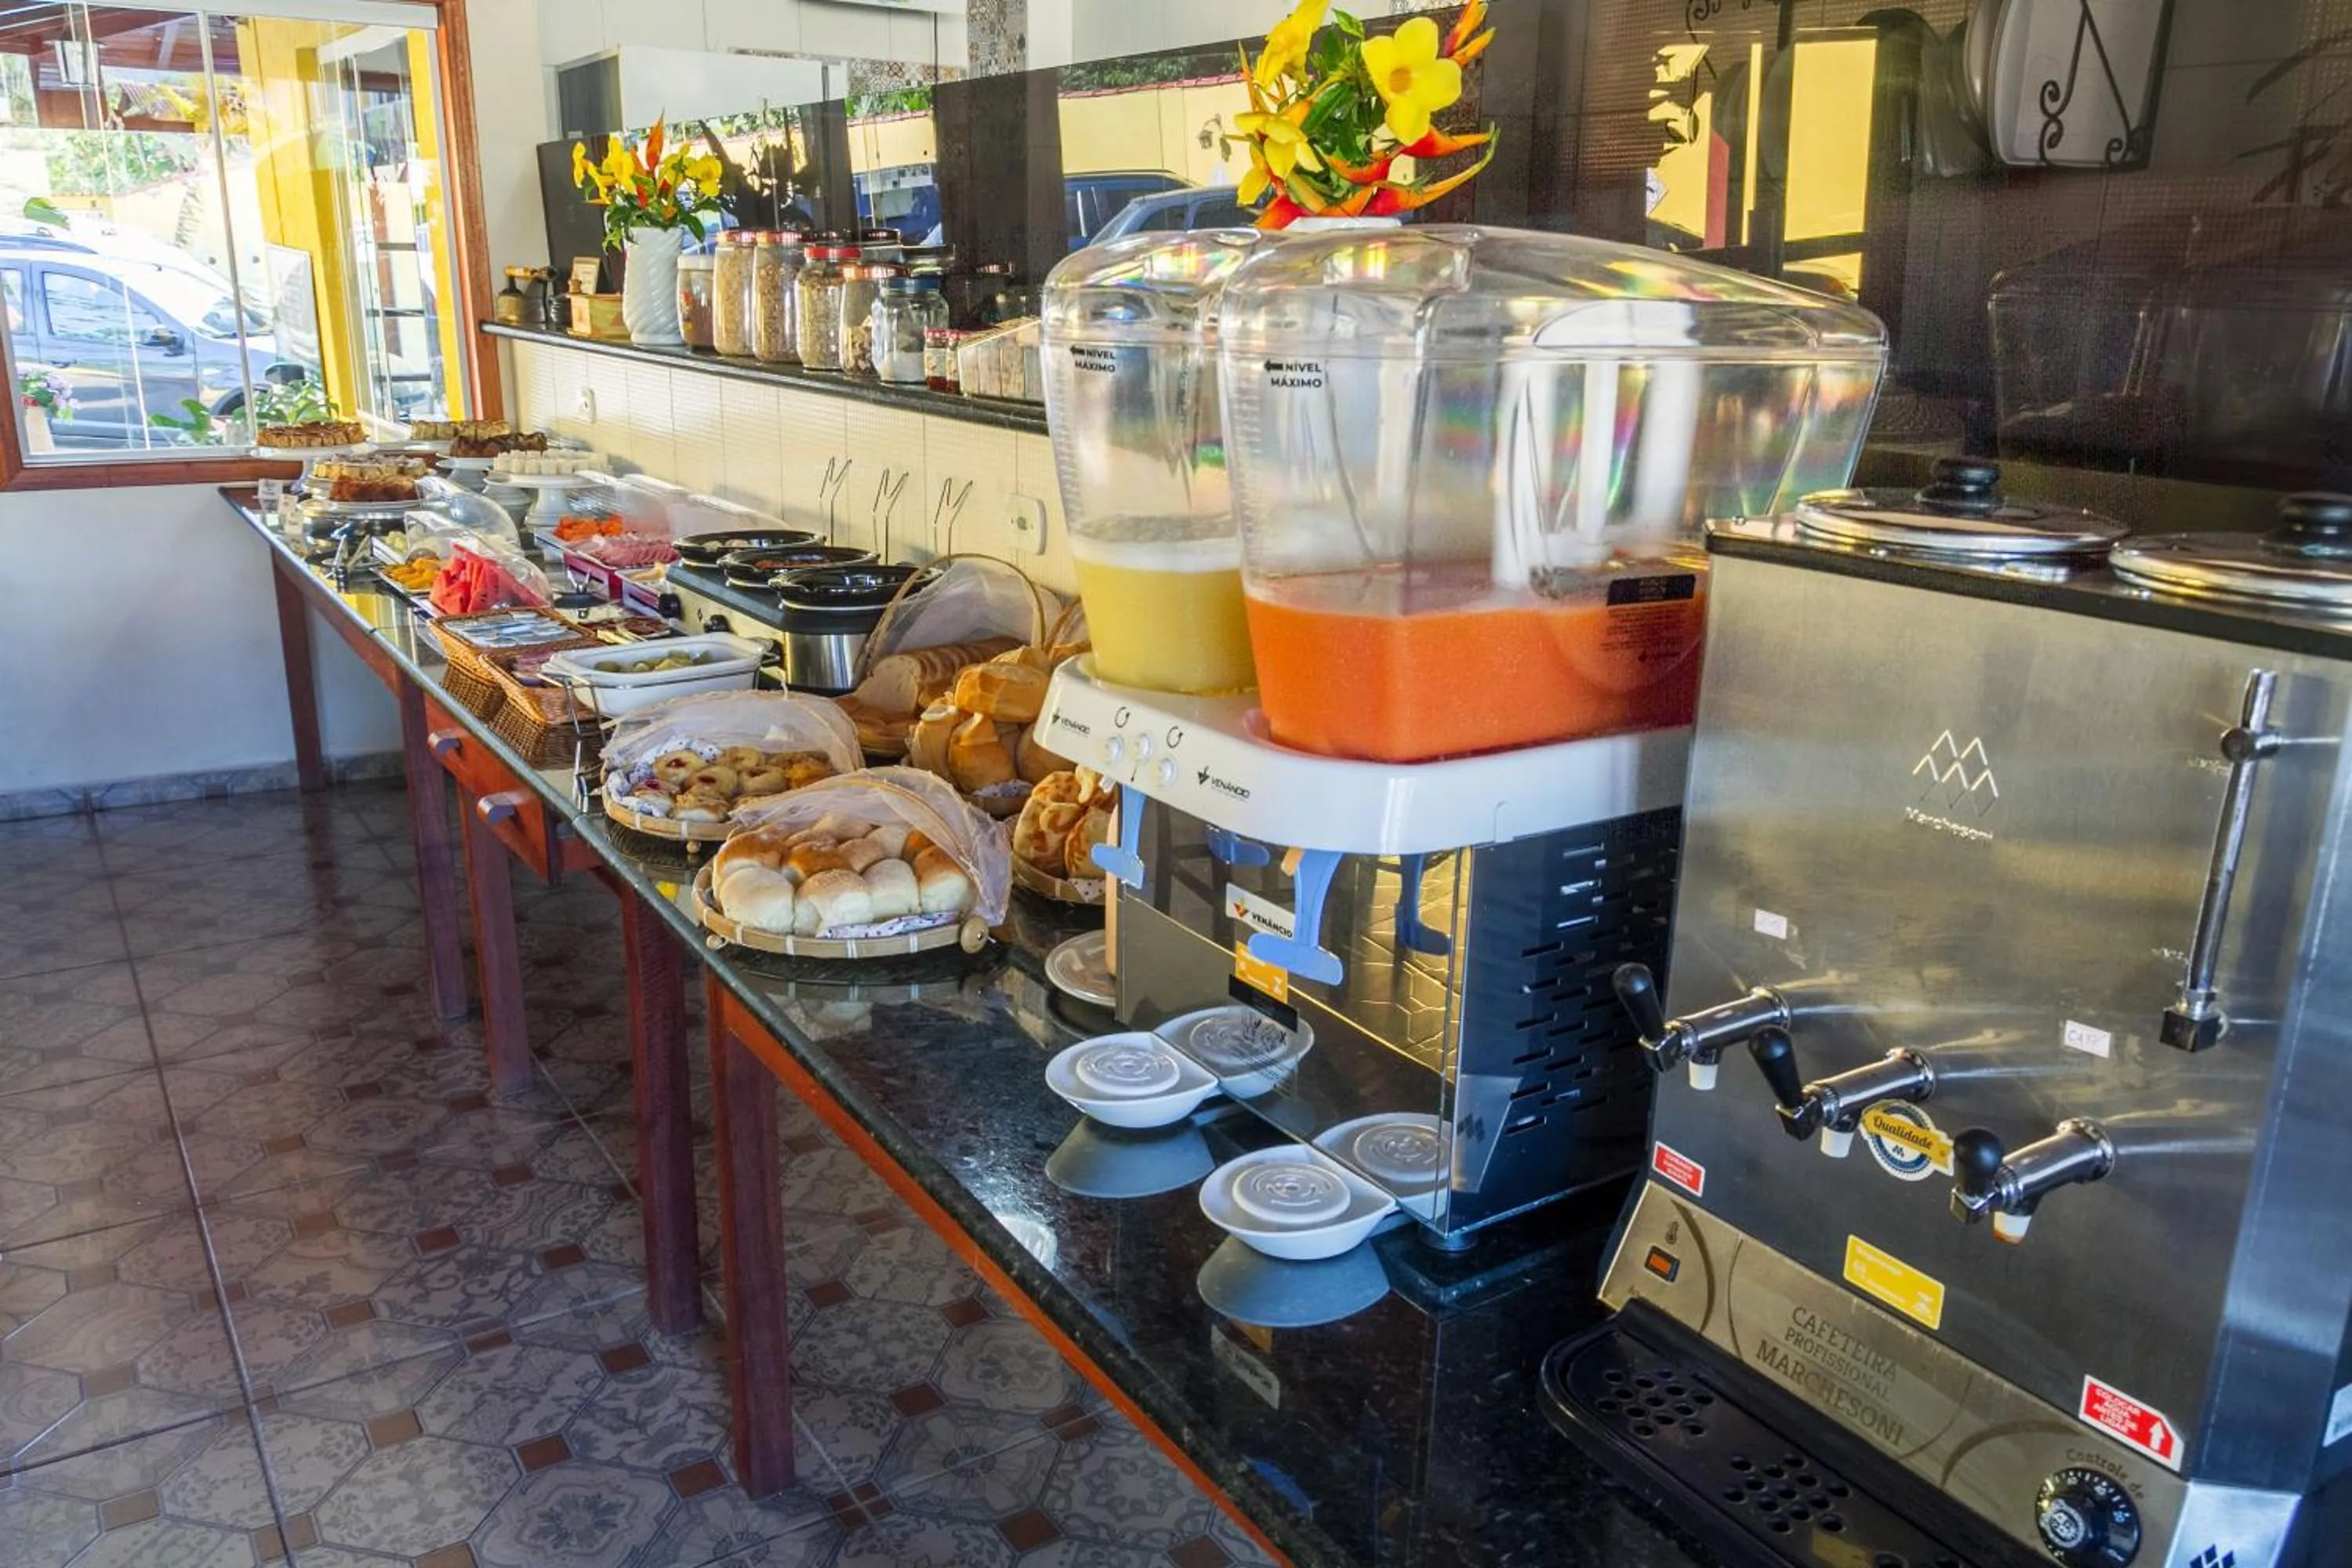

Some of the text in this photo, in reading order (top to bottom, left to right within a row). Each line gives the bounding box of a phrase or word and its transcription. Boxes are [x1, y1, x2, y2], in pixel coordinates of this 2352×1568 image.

[1873, 1115, 1933, 1149] Qualidade
[1784, 1327, 1890, 1402] PROFISSIONAL
[1792, 1305, 1897, 1383] CAFETEIRA
[1755, 1339, 1906, 1447] MARCHESONI
